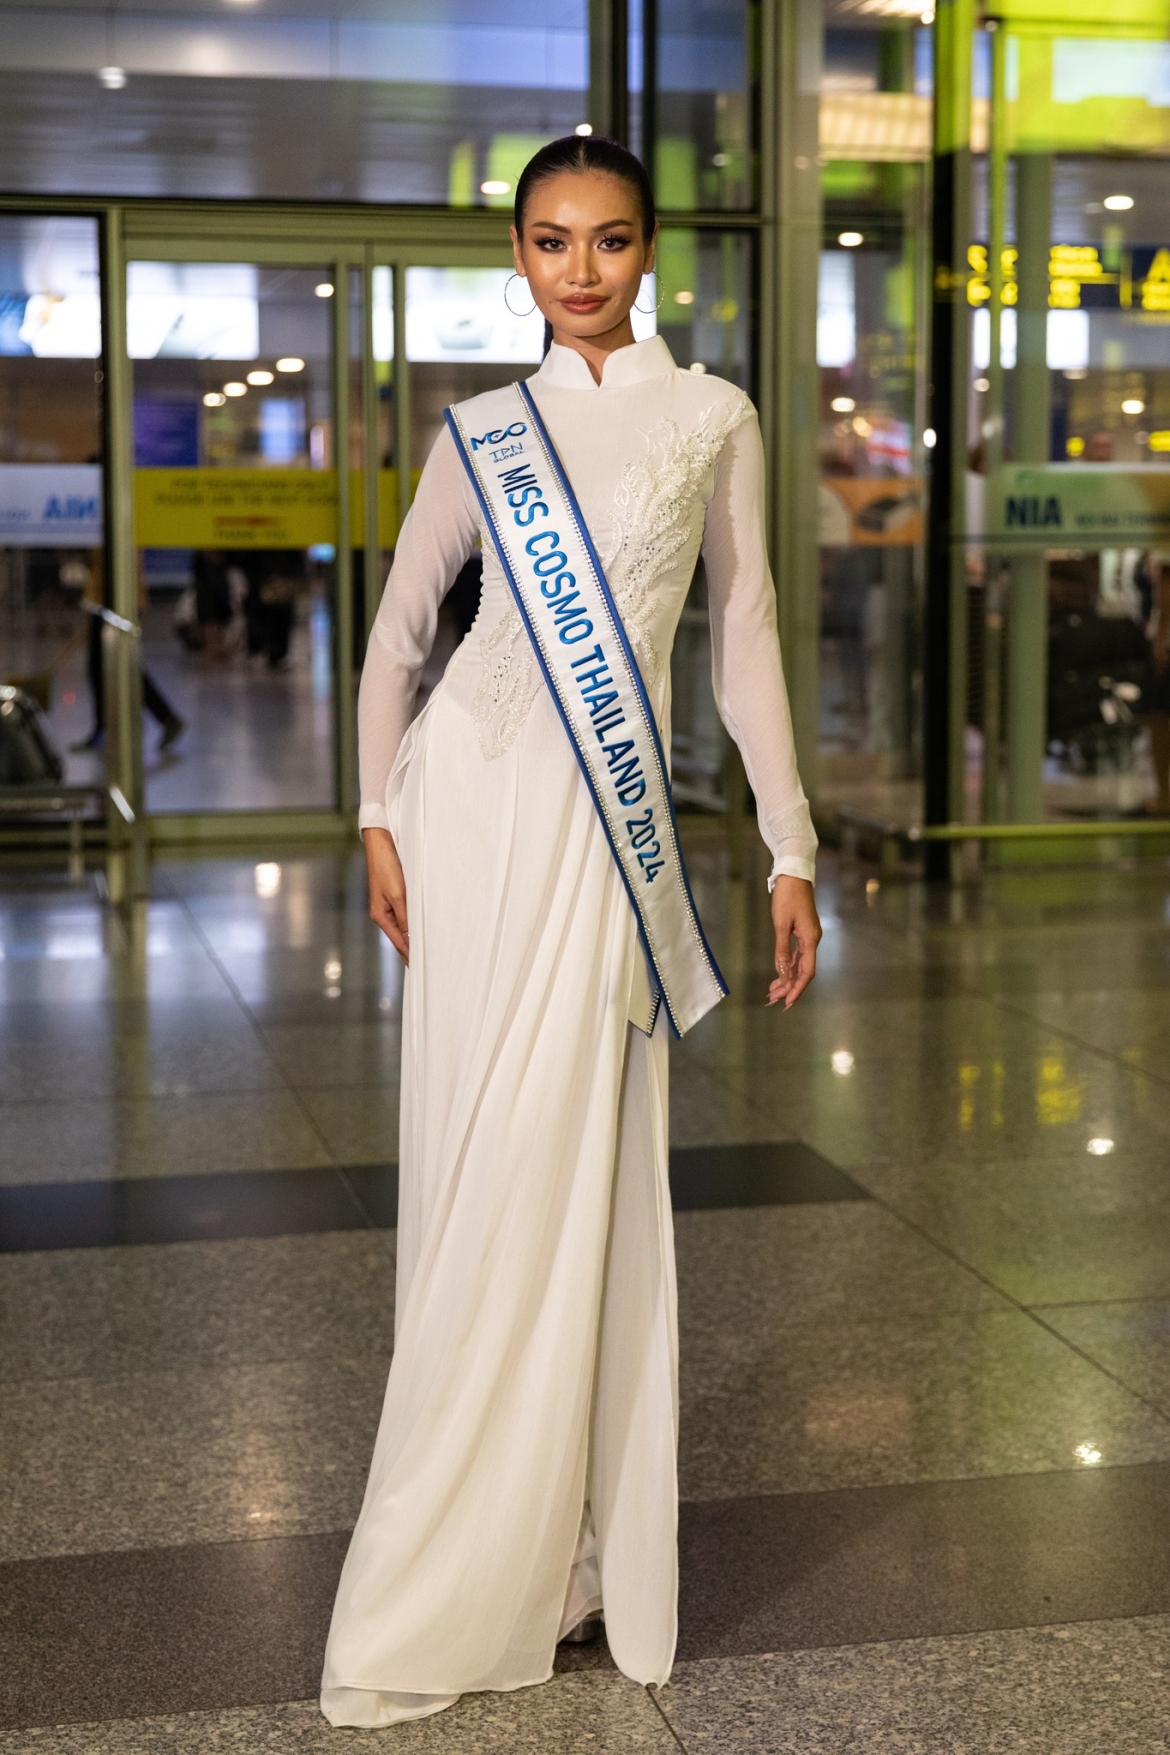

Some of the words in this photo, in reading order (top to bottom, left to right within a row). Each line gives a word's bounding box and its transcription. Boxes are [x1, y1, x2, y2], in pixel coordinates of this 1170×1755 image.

[493, 451, 525, 463] GLOBAL
[497, 463, 549, 527] MISS
[525, 531, 594, 645] COSMO
[570, 643, 646, 807] THAILAND
[625, 808, 665, 883] 2024
